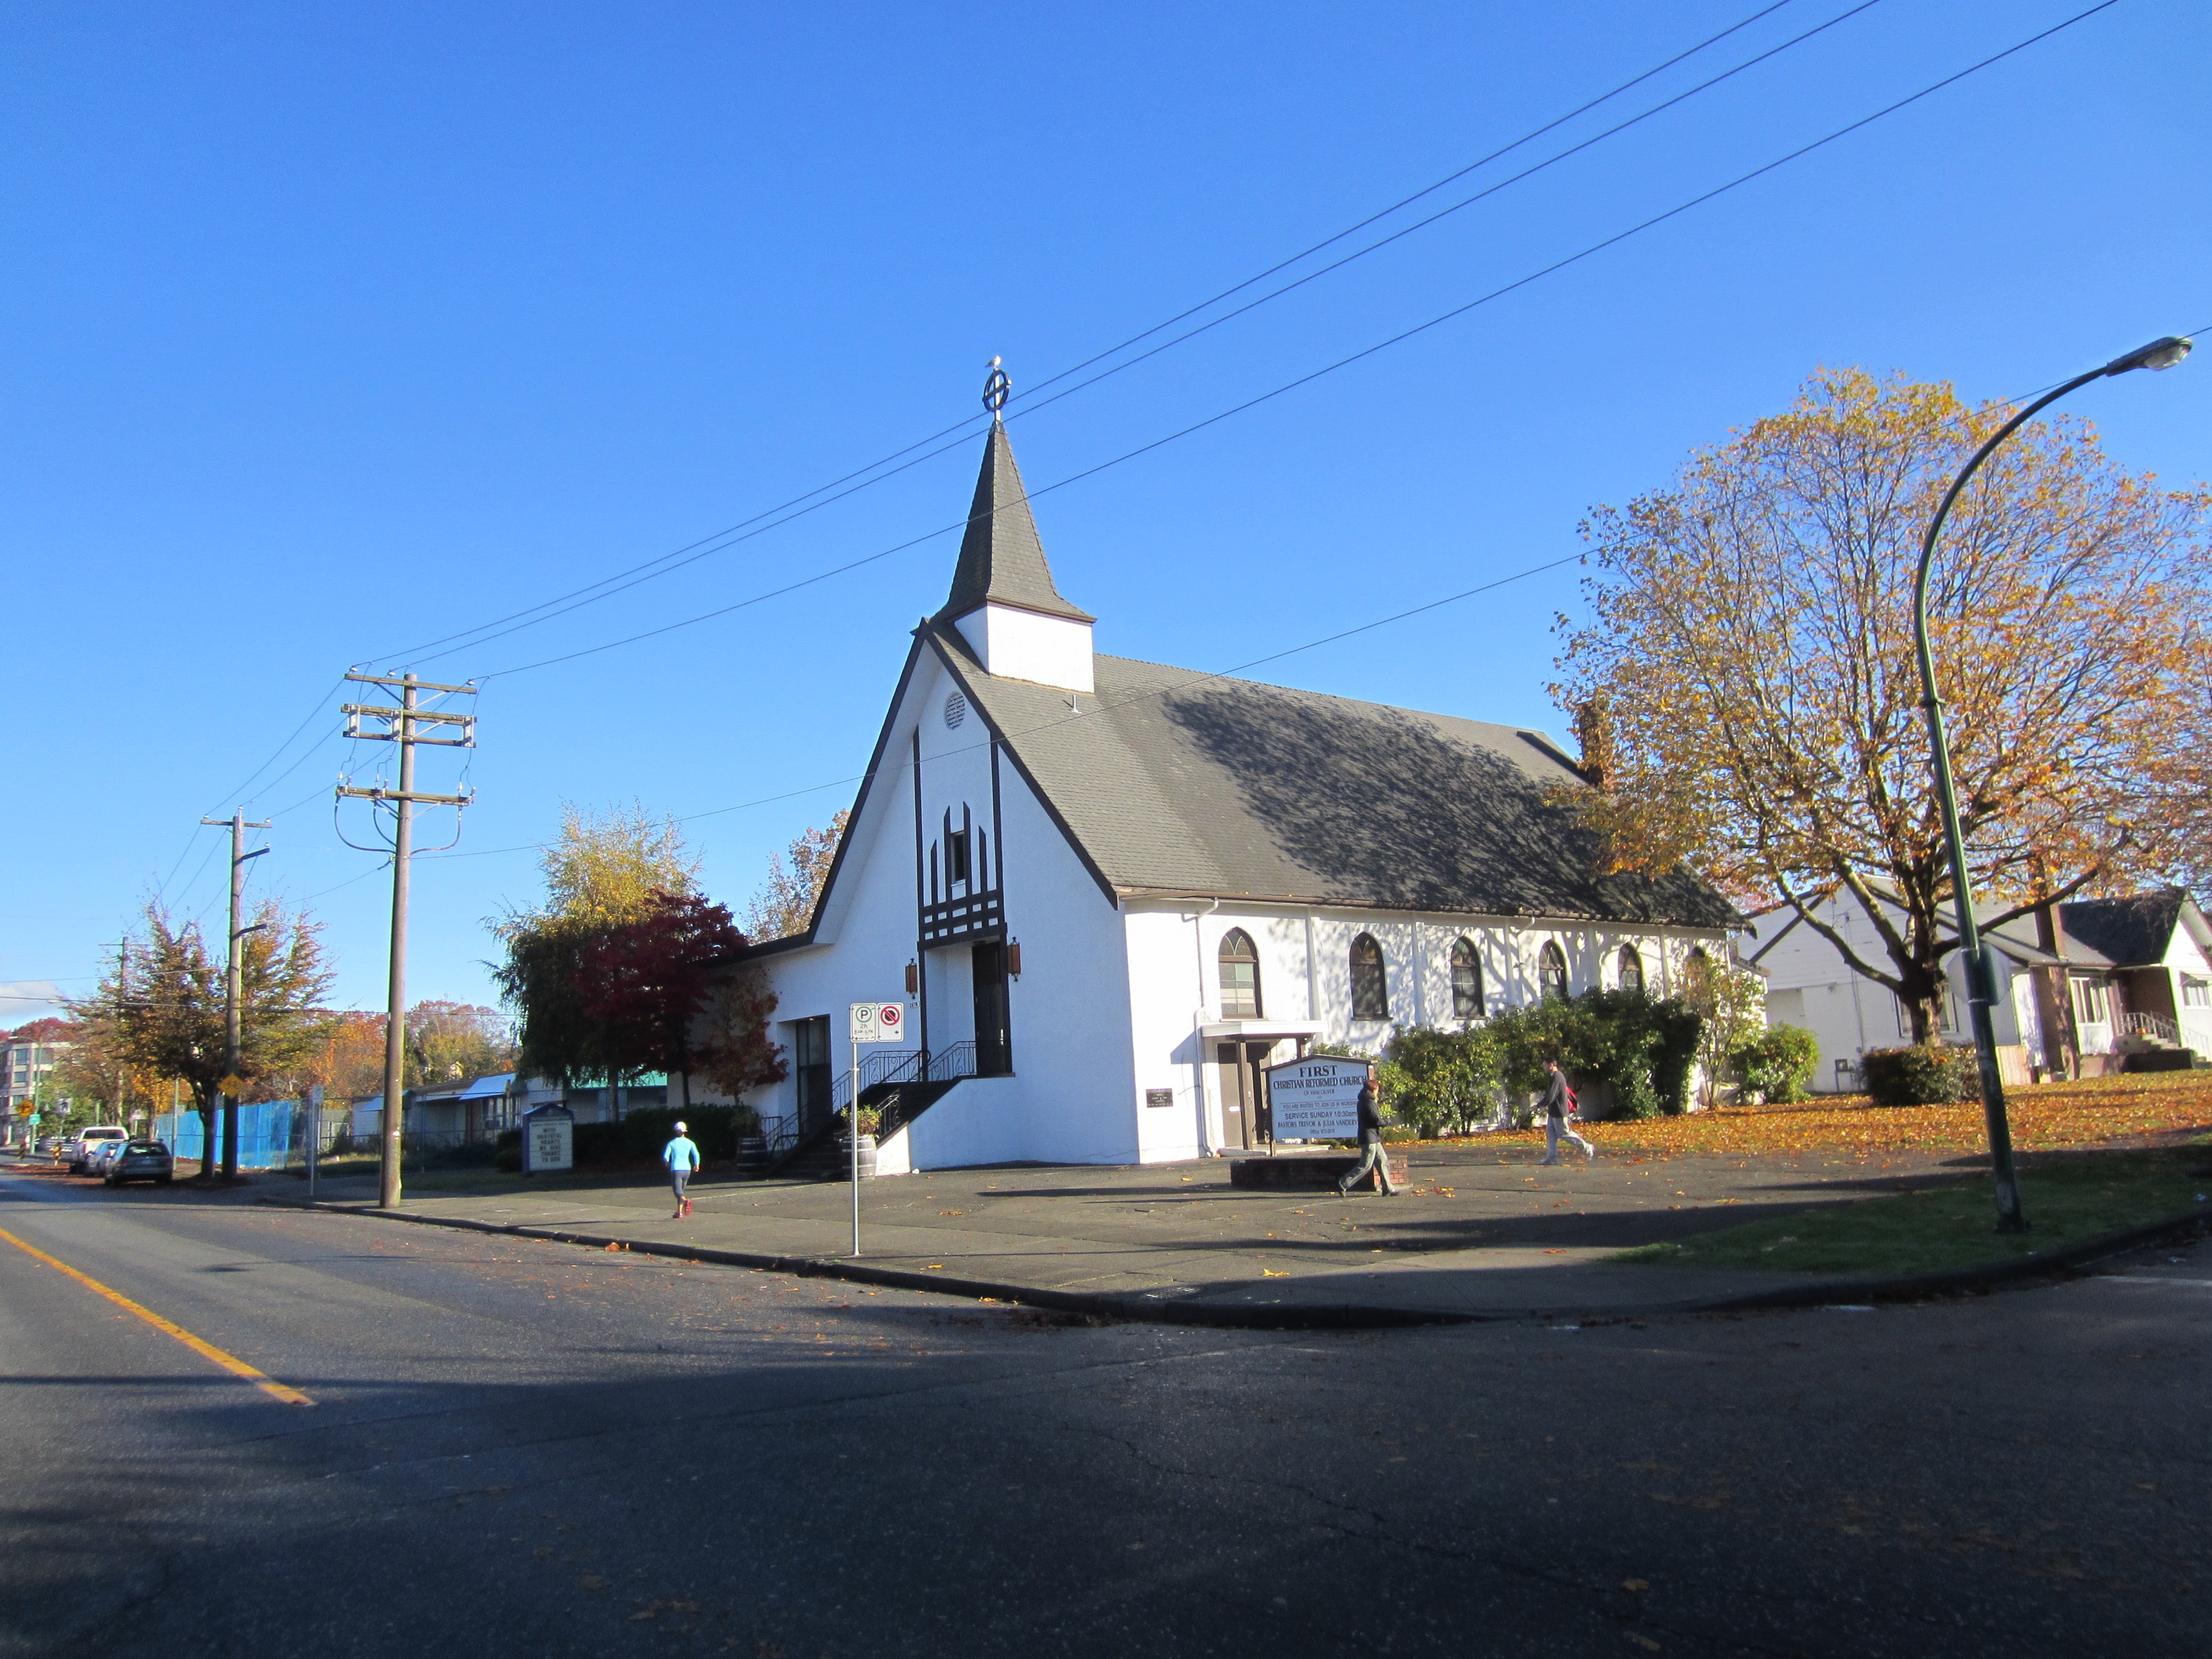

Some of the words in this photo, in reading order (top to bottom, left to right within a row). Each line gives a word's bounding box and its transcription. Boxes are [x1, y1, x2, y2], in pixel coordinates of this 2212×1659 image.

[860, 1010, 868, 1019] P
[1299, 1065, 1337, 1077] FIRST
[1274, 1080, 1304, 1089] CHRISTIAN
[1306, 1077, 1338, 1088] REFORMED
[1339, 1076, 1366, 1086] CHURCH
